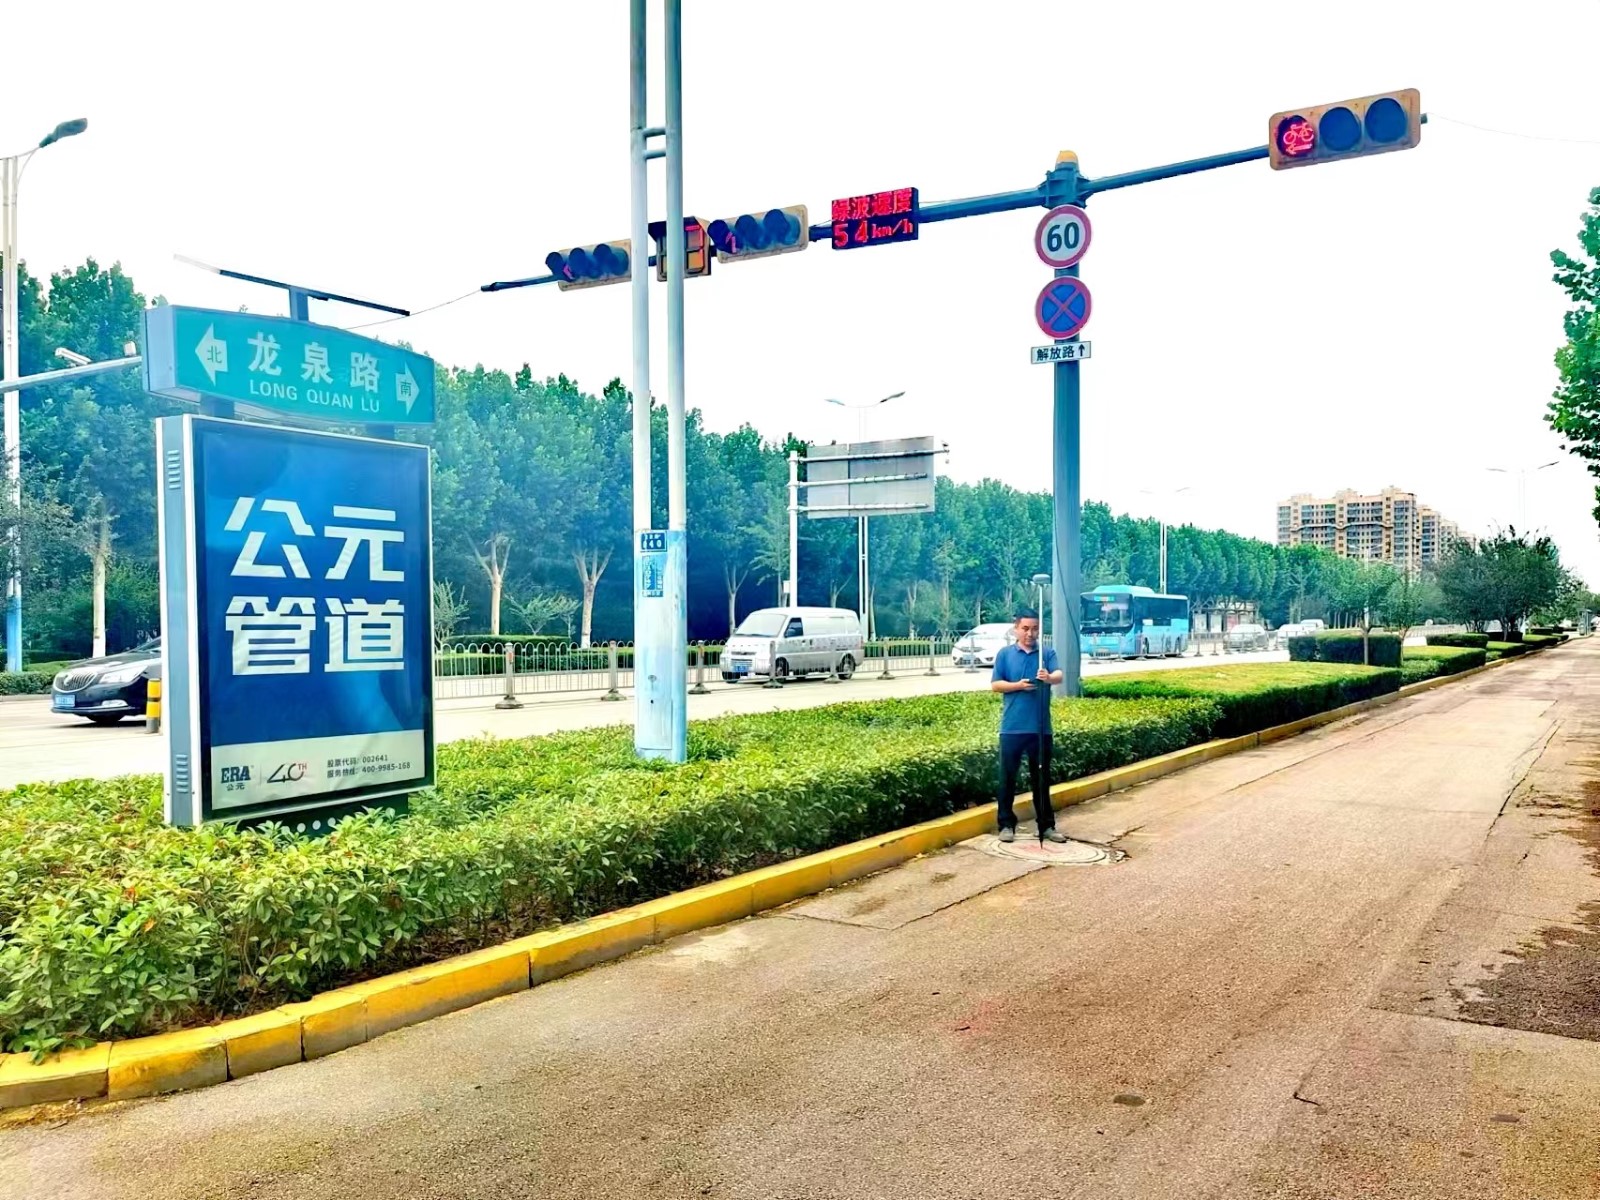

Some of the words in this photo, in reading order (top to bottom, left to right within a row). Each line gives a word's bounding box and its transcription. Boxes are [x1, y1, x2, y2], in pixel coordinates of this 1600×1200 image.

[1047, 222, 1079, 252] 60
[207, 346, 222, 364] 北
[247, 331, 380, 393] 龙泉路
[1036, 346, 1075, 361] 解放路
[249, 379, 298, 401] LONG
[306, 389, 354, 410] QUAN
[361, 397, 380, 413] LU
[400, 381, 412, 397] 南
[224, 496, 405, 582] 公元
[225, 596, 405, 676] 管道
[221, 765, 251, 784] ERA
[226, 783, 245, 791] 公元
